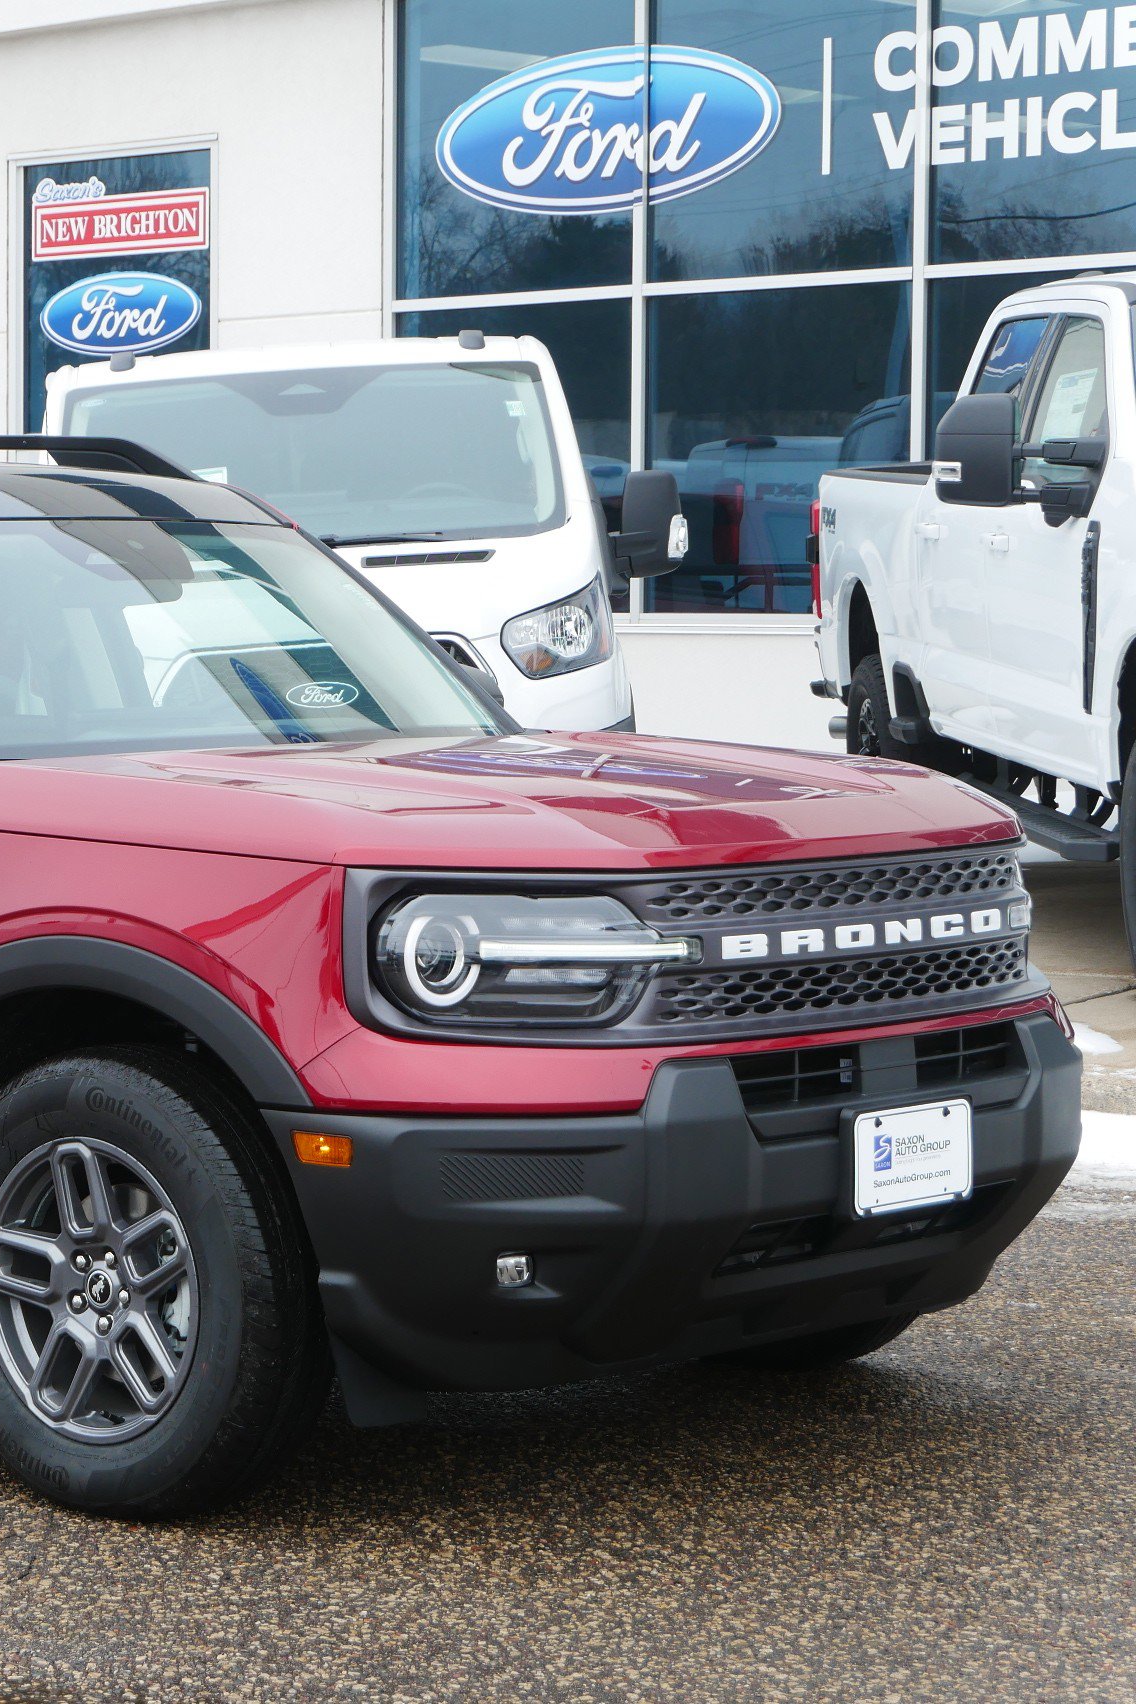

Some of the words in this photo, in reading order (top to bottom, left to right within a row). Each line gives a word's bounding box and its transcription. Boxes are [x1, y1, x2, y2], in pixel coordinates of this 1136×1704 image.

[502, 75, 706, 187] Ford
[872, 88, 1136, 170] VEHICL
[35, 178, 103, 203] Saxon's
[42, 215, 88, 243] NEW
[93, 207, 197, 239] BRIGHTON
[72, 284, 168, 340] Ford
[301, 685, 344, 703] Ford
[721, 908, 1001, 960] BRONCO
[85, 1086, 189, 1163] Continental
[895, 1134, 925, 1147] SAXON
[895, 1145, 918, 1157] AUTO
[920, 1140, 951, 1153] GROUP
[873, 1169, 951, 1188] SaxonAutoGroup.com
